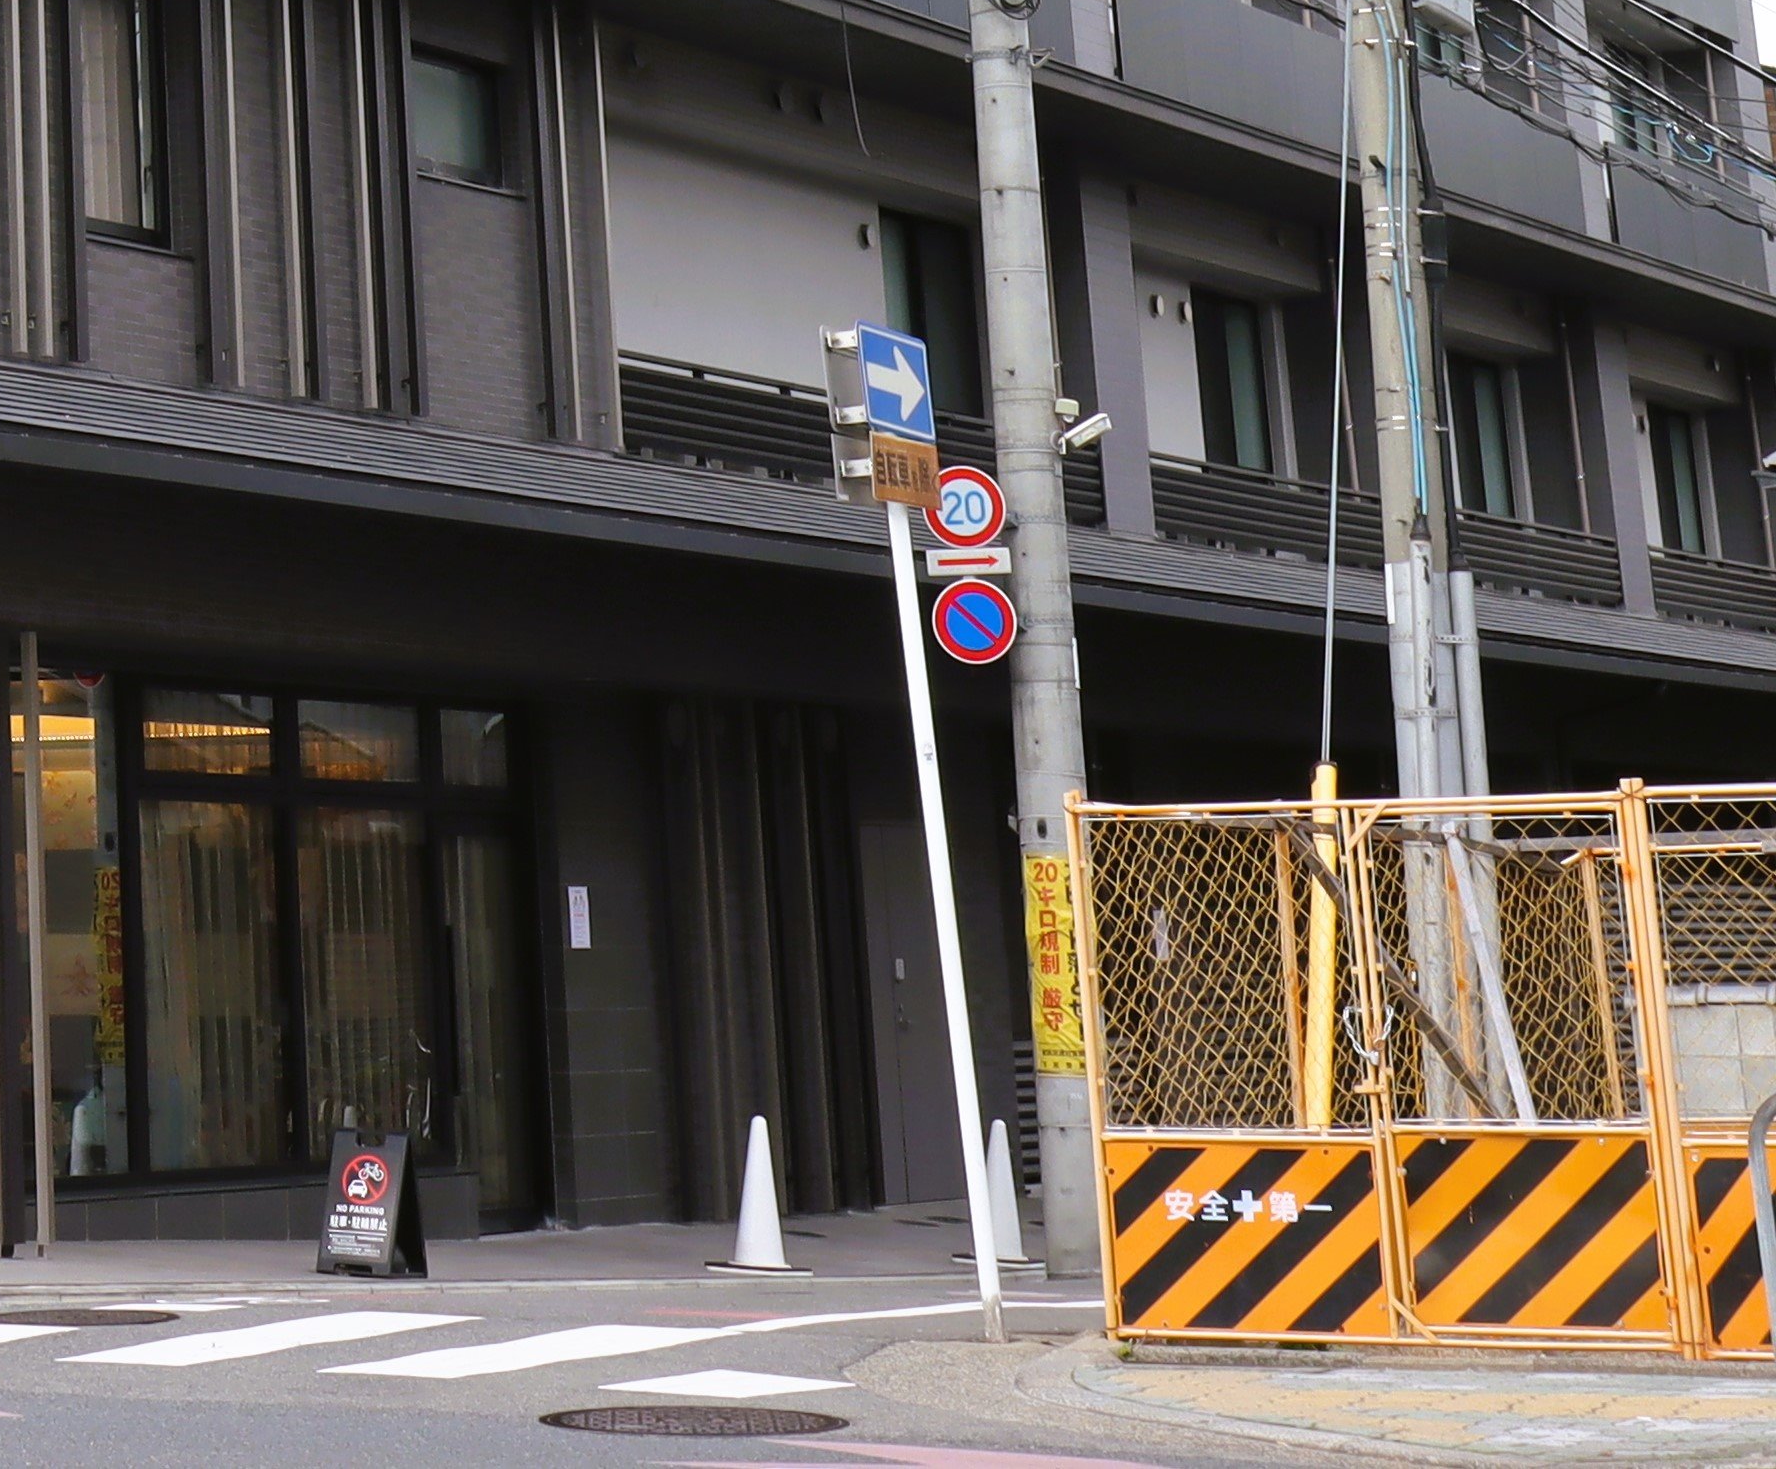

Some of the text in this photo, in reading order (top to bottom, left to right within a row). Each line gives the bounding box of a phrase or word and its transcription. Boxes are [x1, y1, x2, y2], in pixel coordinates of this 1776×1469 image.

[943, 490, 986, 525] 20
[335, 1204, 385, 1215] NO PARKING
